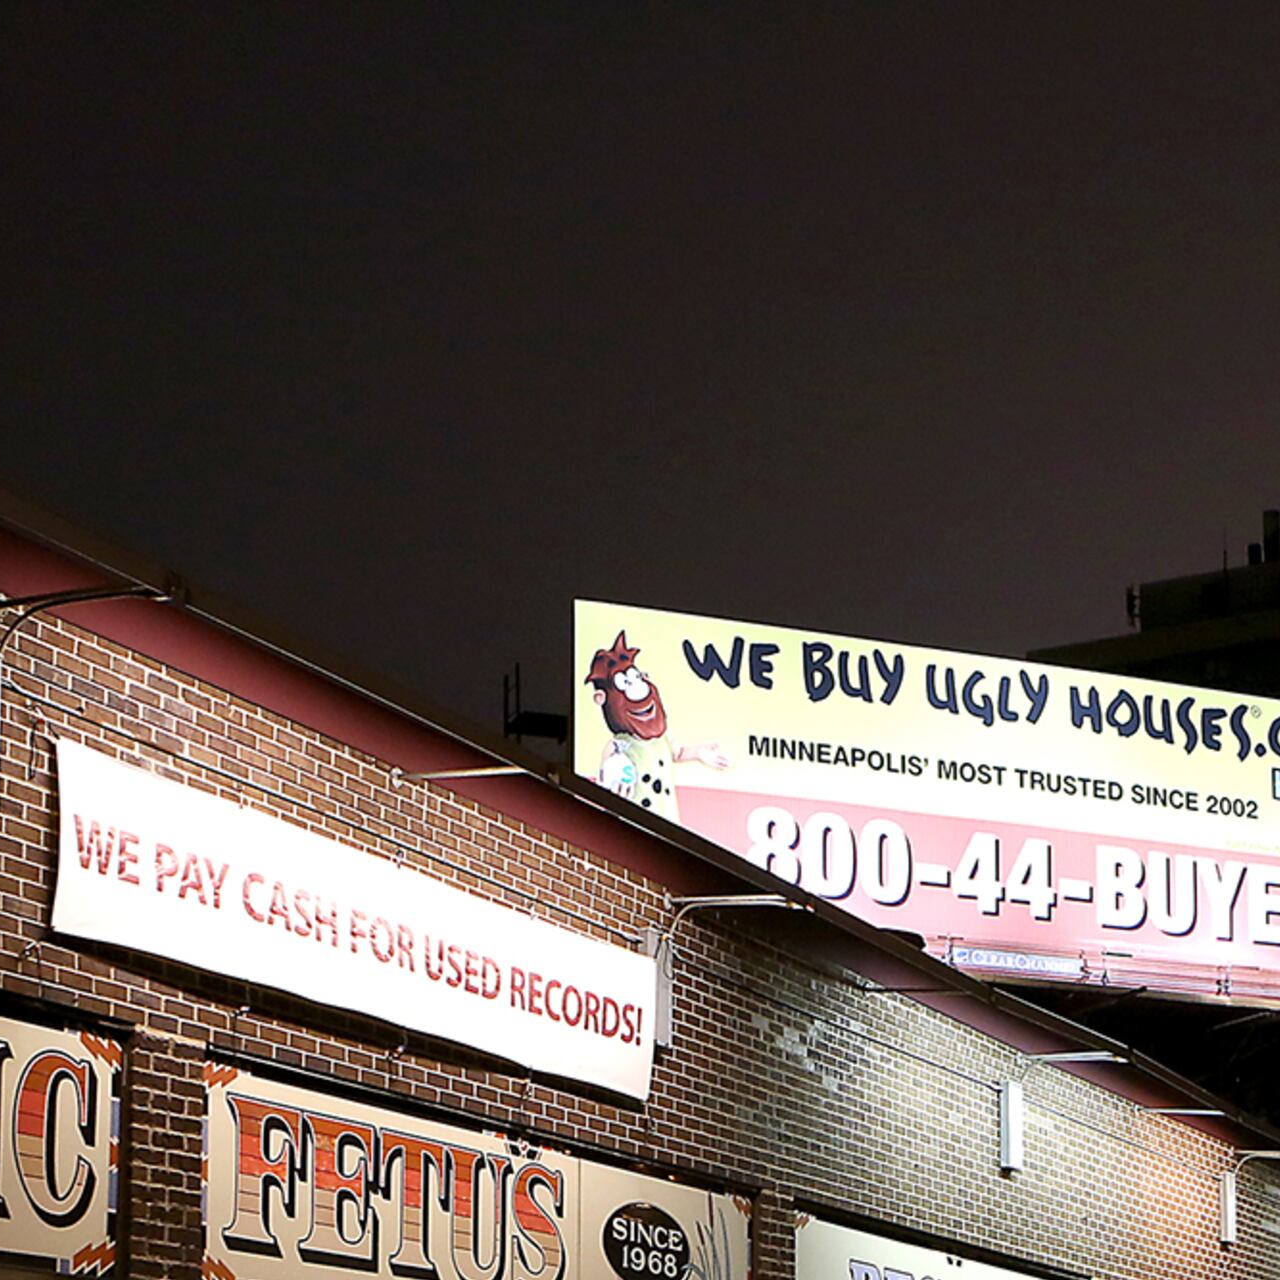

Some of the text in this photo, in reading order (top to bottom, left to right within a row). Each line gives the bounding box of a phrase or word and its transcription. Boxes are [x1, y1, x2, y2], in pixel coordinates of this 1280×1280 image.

[682, 636, 780, 689] WE
[803, 641, 904, 706] BUY
[926, 664, 1049, 727] UGLY
[937, 760, 1007, 786] MOST
[1015, 769, 1123, 801] TRUSTED
[1131, 784, 1199, 813] SINCE
[1206, 796, 1259, 820] 2002
[73, 813, 643, 1049] WE PAY CASH FOR USED RECORDS!
[612, 1217, 683, 1252] SINCE
[622, 1244, 677, 1278] 1968
